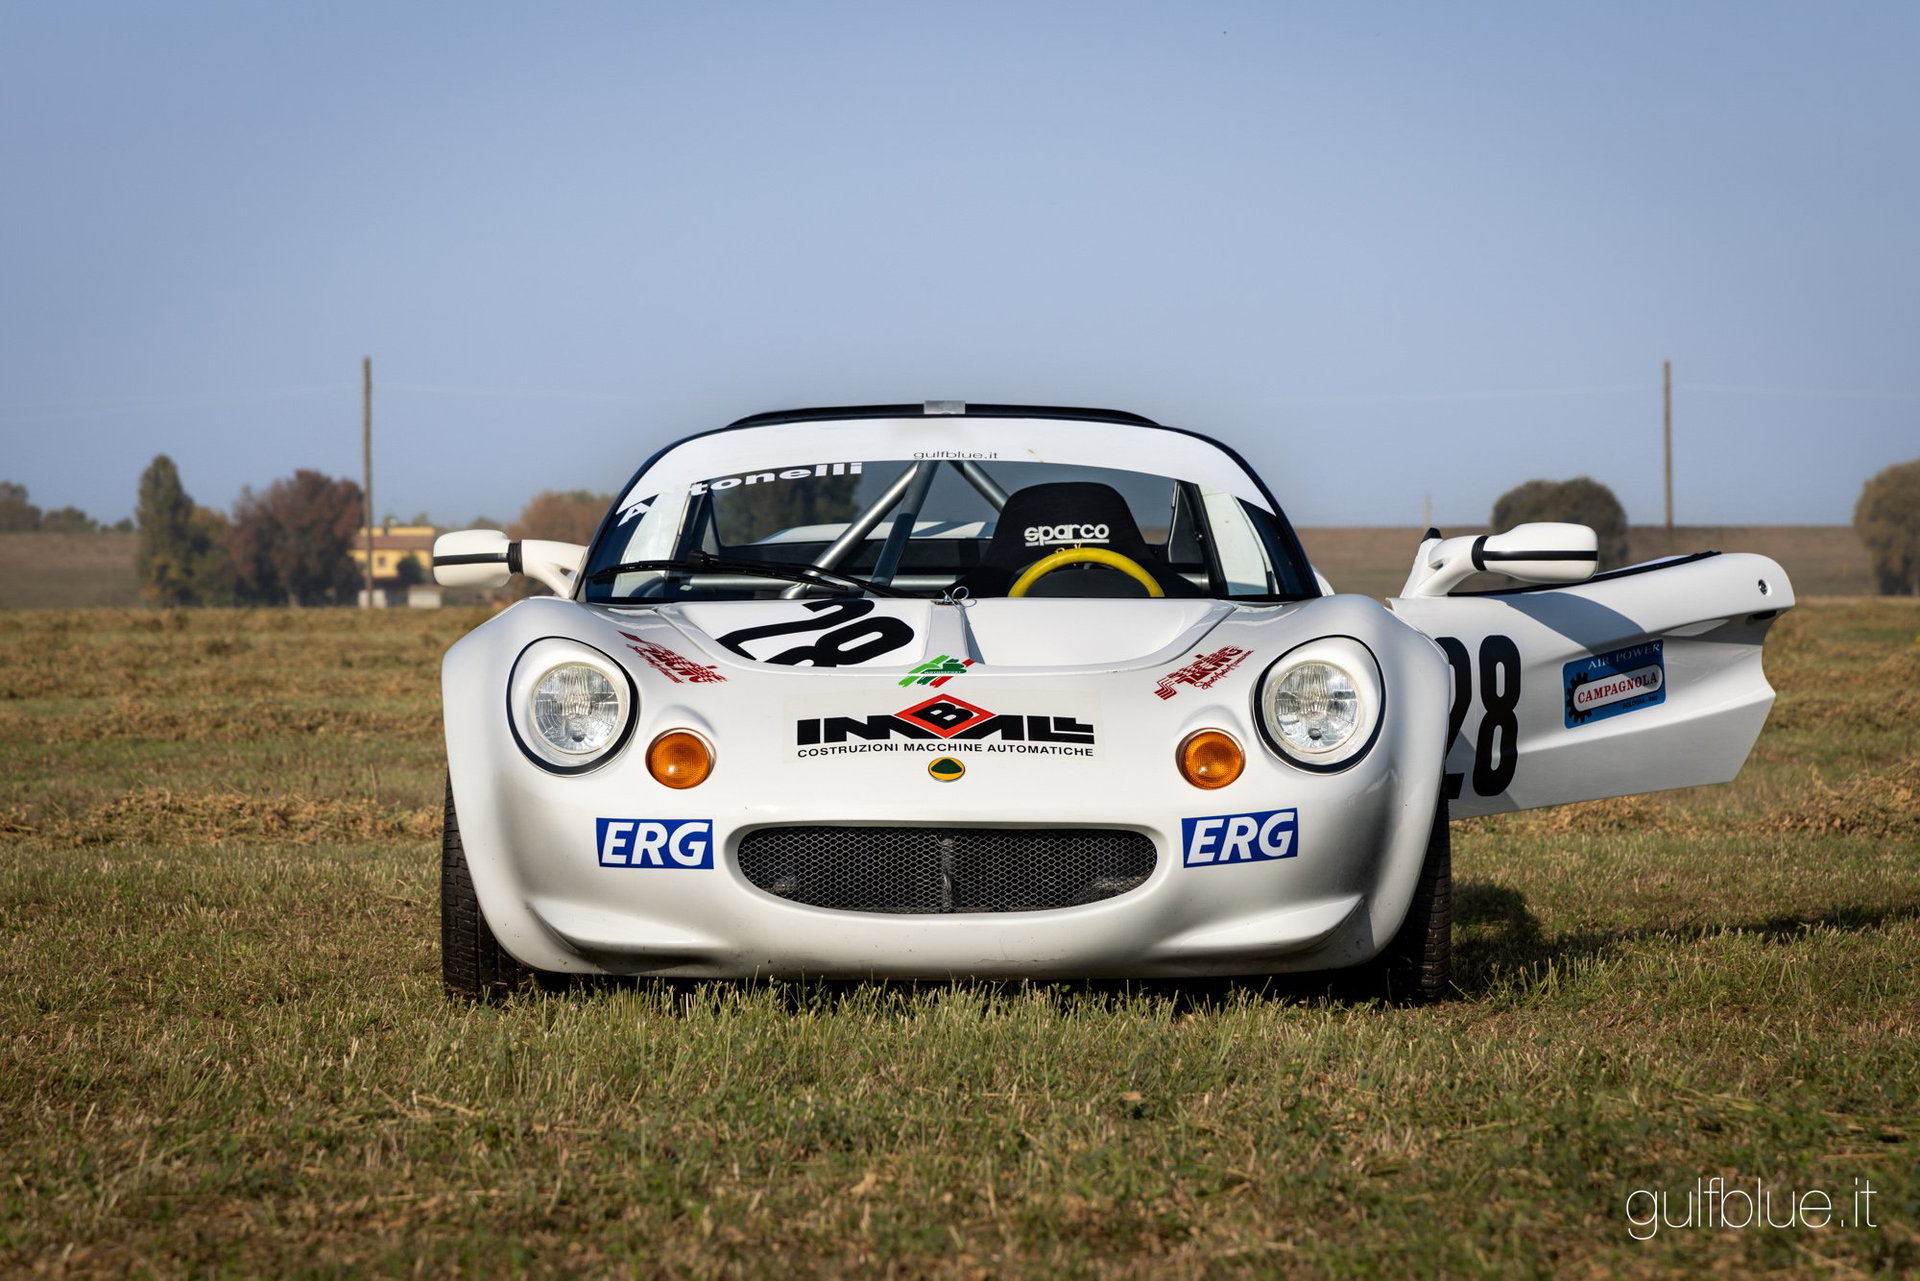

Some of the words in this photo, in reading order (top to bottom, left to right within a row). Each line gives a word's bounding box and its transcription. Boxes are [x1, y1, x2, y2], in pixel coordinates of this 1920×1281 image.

[913, 450, 999, 460] gulfblue.it
[1024, 523, 1110, 547] sparco
[1588, 658, 1610, 671] AIR
[1615, 643, 1661, 663] POWER
[1577, 672, 1659, 704] CAMPAGNOLA
[797, 743, 899, 758] COSTRUZIONI
[904, 743, 983, 752] MACCHINE
[987, 744, 1095, 757] AUTOMATICHE
[601, 821, 709, 866] ERG
[1186, 811, 1295, 864] ERG
